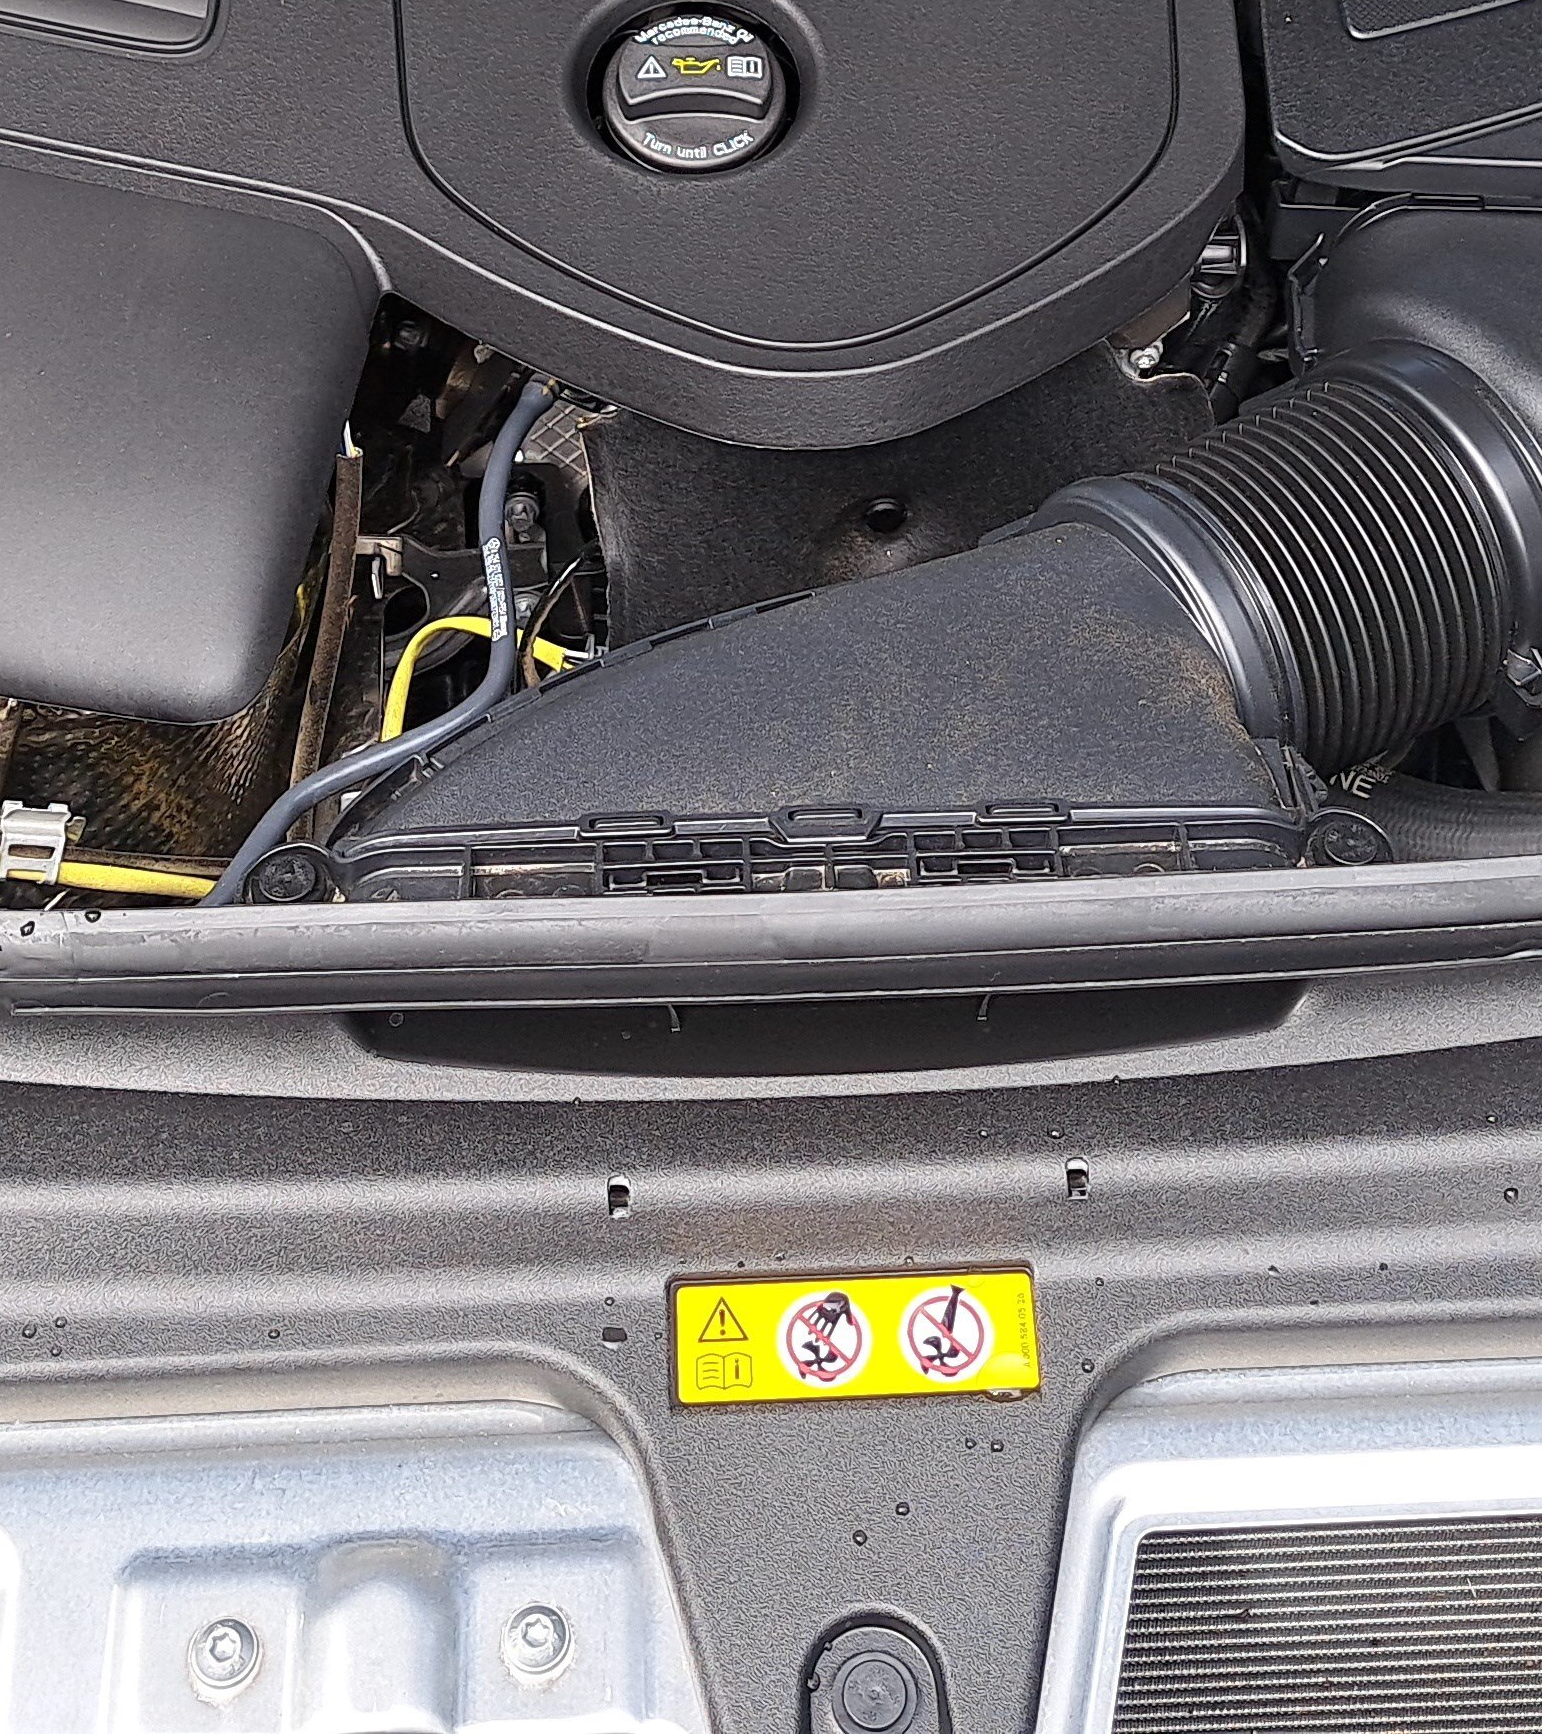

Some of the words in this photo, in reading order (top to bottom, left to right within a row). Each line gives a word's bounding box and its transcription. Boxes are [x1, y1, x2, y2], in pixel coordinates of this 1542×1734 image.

[643, 132, 672, 155] Turn
[676, 145, 707, 159] until
[712, 129, 755, 156] CLICK
